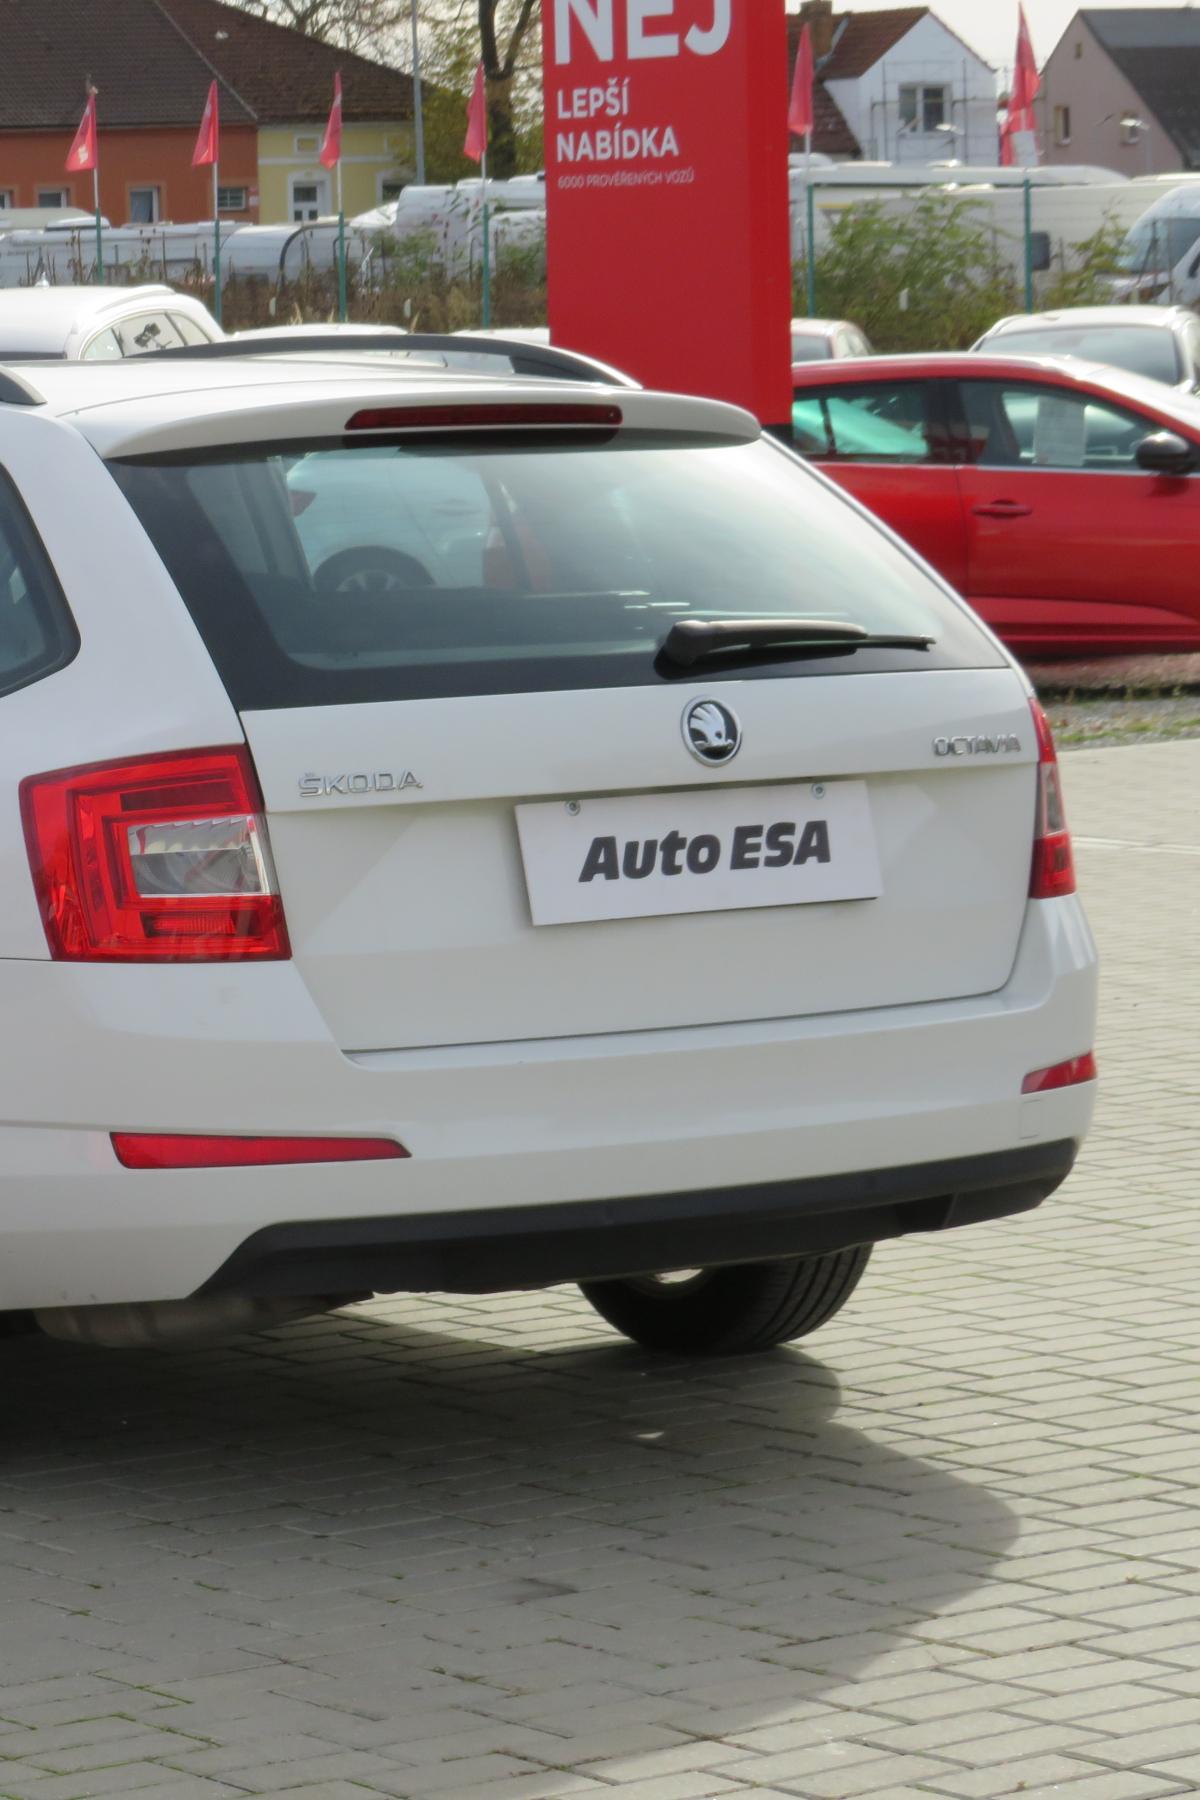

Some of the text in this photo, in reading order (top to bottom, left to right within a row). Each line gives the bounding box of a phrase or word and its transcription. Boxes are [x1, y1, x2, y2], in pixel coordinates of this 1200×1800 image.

[554, 0, 732, 65] NEJ
[557, 77, 631, 119] LEPŠÍ
[556, 122, 680, 163] NABÍDKA
[298, 770, 423, 798] ŠKODA
[578, 820, 831, 883] Auto ESA
